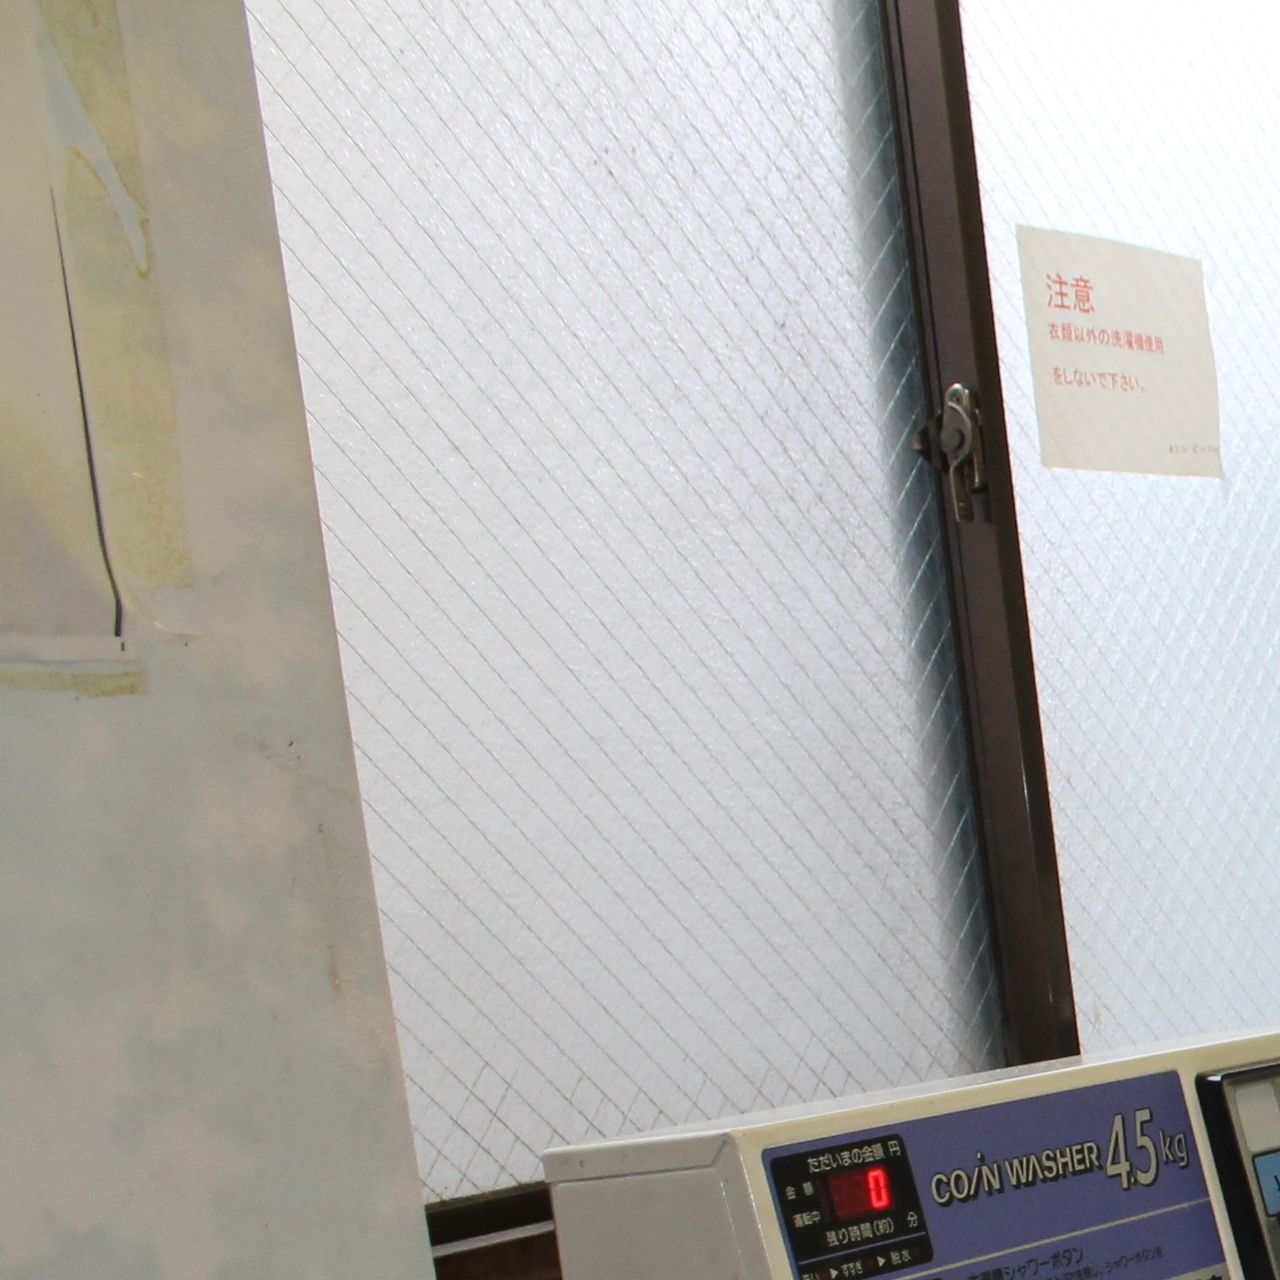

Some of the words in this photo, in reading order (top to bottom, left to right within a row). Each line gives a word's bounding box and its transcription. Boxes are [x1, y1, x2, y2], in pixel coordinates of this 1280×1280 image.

[1045, 273, 1095, 314] 注意
[807, 1143, 886, 1173] ただいまの金額
[887, 1140, 901, 1157] 円
[1004, 1141, 1101, 1187] WASHER
[867, 1167, 890, 1209] 0
[906, 1211, 918, 1228] 分
